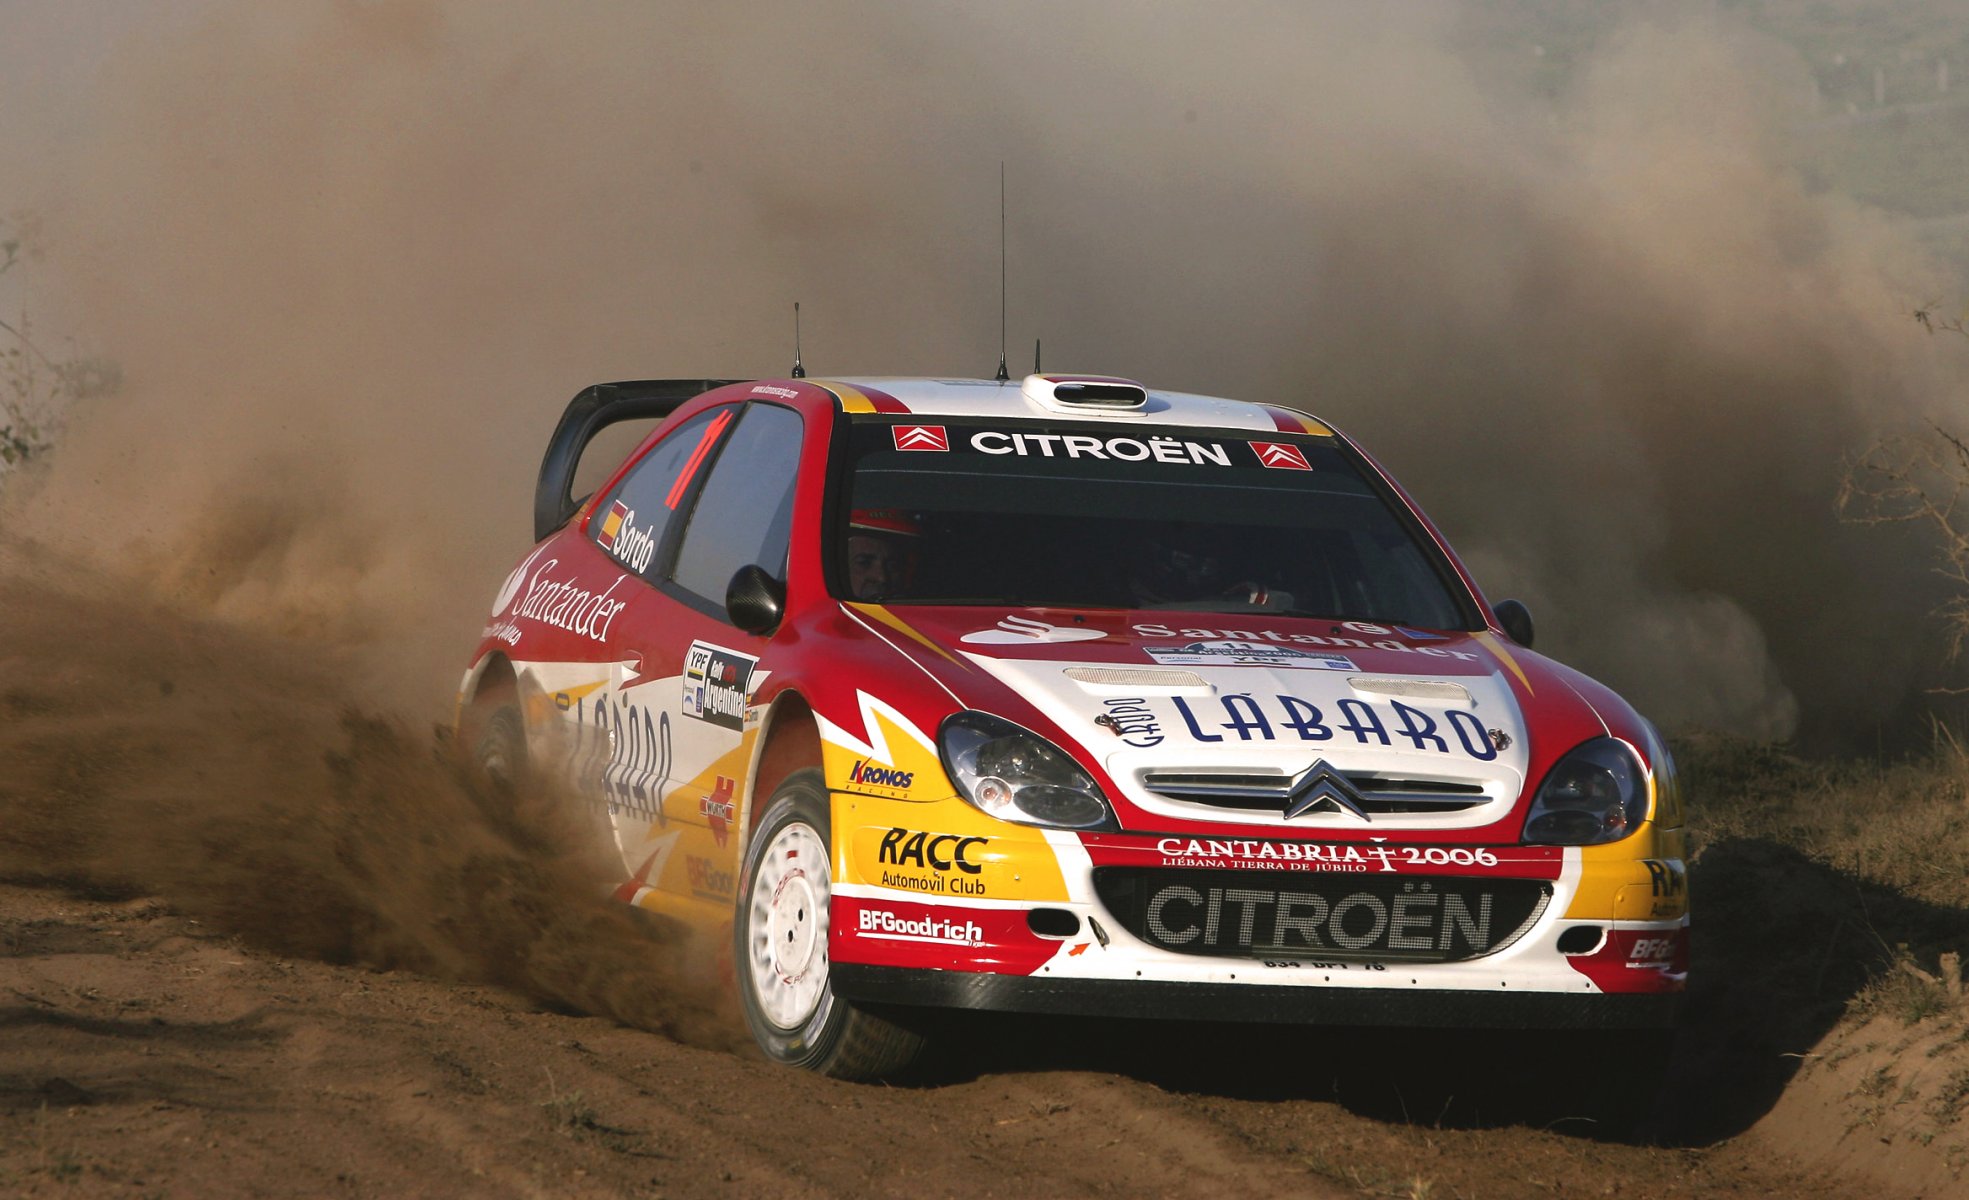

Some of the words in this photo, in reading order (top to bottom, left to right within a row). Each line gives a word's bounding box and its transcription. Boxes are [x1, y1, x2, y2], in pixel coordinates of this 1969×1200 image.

[970, 431, 1233, 466] CITROËN
[612, 510, 655, 574] Sordo
[512, 558, 629, 643] Santander
[691, 651, 709, 669] YPF
[1132, 623, 1478, 662] Santander
[703, 678, 744, 719] Argentina
[1171, 692, 1498, 762] LÁBARO
[849, 756, 914, 789] KRONOS
[845, 785, 909, 799] RACING
[879, 827, 989, 874] RACC
[1157, 838, 1368, 863] CANTABRIA
[1402, 847, 1499, 867] 2006
[1162, 857, 1227, 868] LIÉBANA
[1231, 860, 1285, 871] TIERRA
[1290, 863, 1311, 871] DE
[1315, 860, 1367, 873] JÚBILO
[882, 871, 945, 892] Automóvil
[950, 878, 986, 895] Club
[859, 909, 983, 942] BFGoodrich
[1147, 881, 1494, 950] CITROËN
